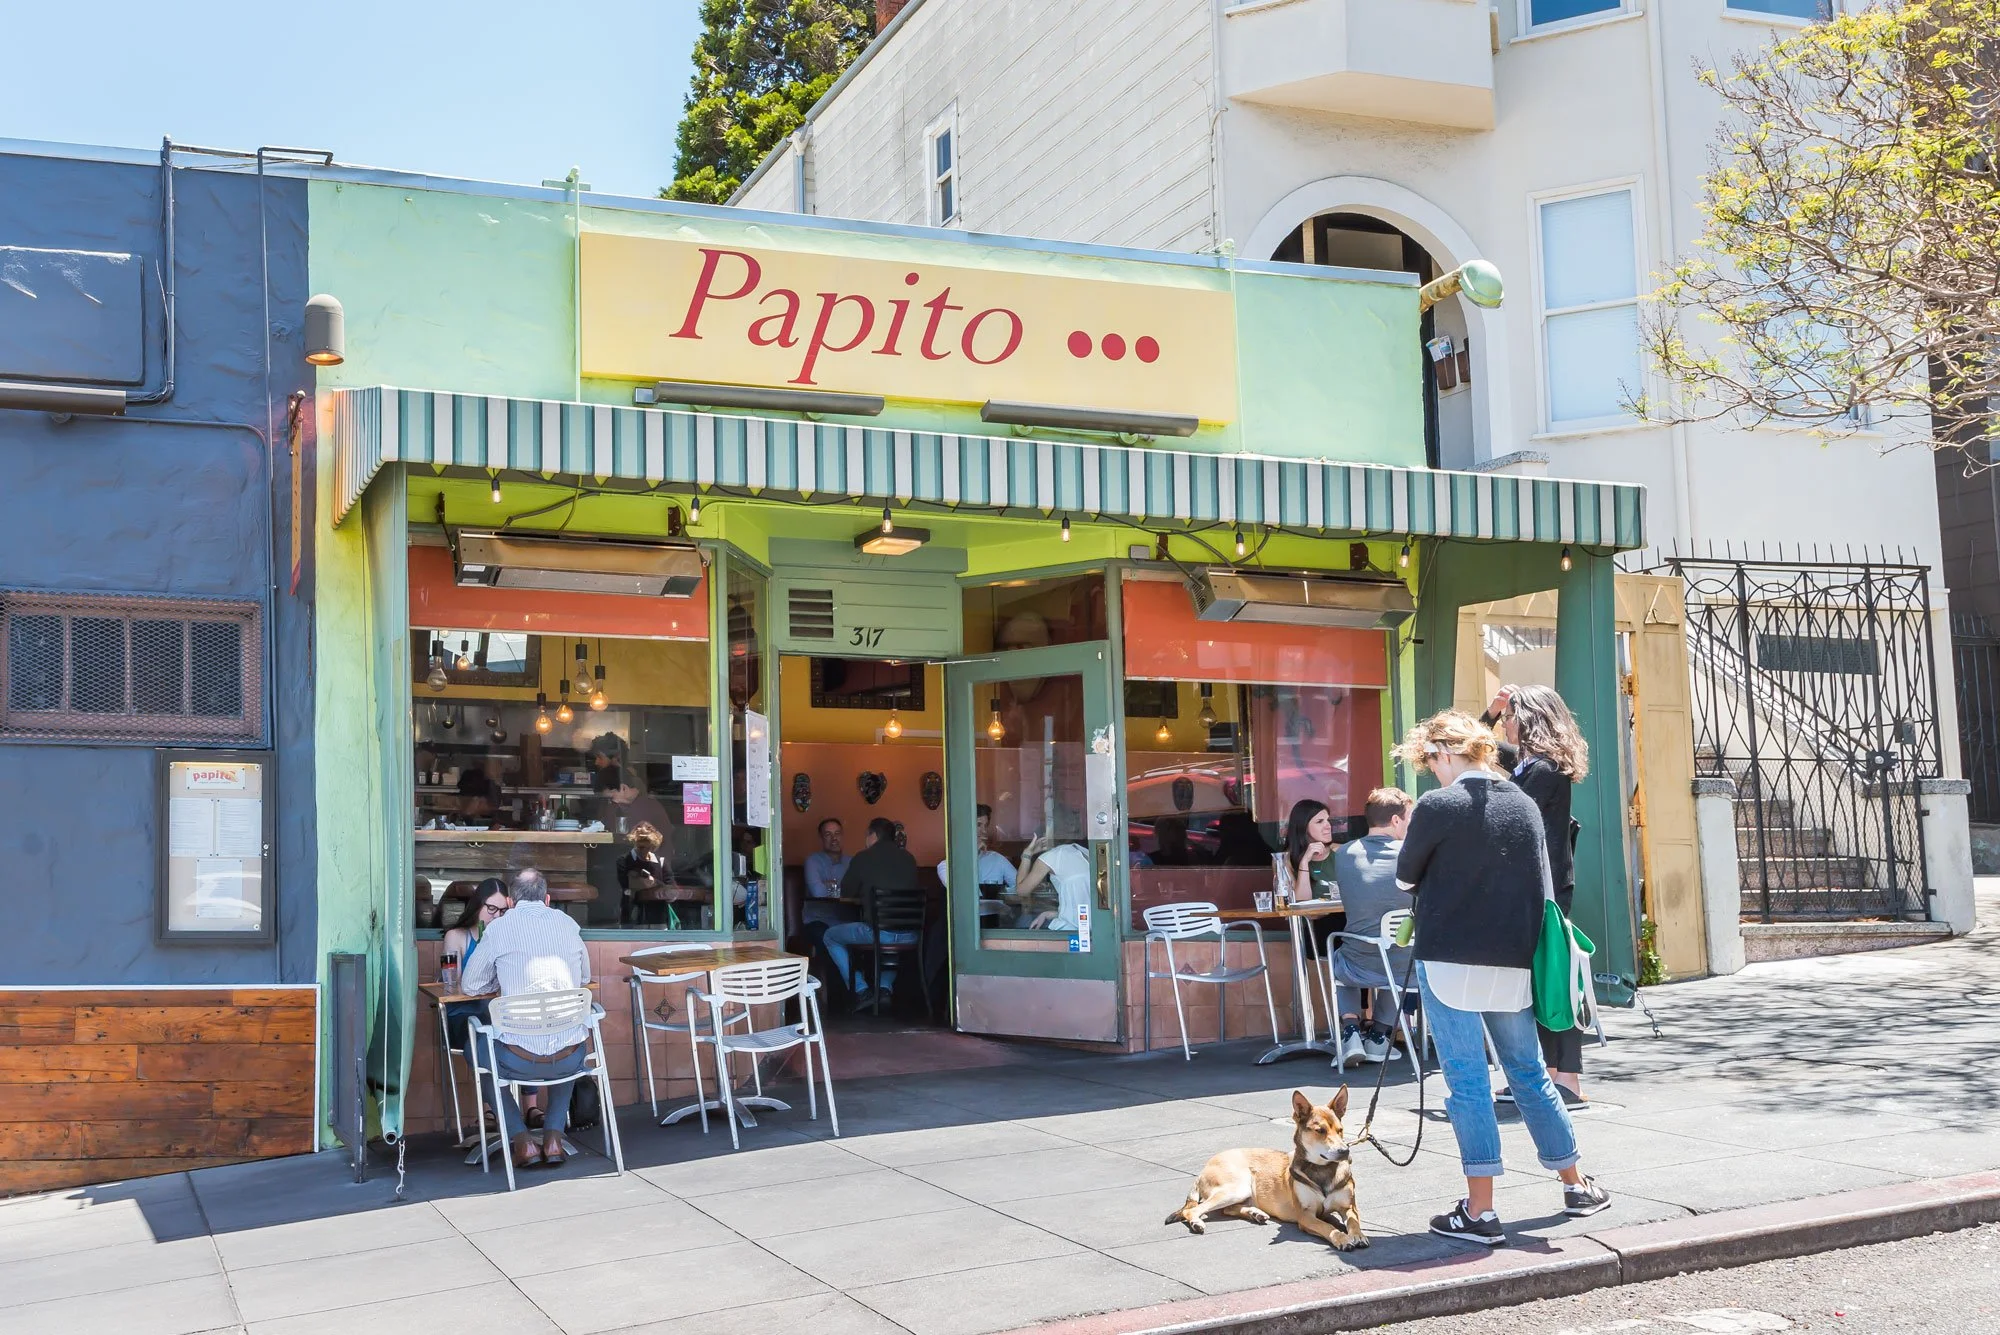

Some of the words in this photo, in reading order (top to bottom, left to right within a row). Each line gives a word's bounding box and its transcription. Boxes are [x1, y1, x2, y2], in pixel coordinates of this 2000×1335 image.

[669, 248, 1024, 386] Papito
[850, 626, 885, 648] 317
[1449, 1215, 1465, 1229] N
